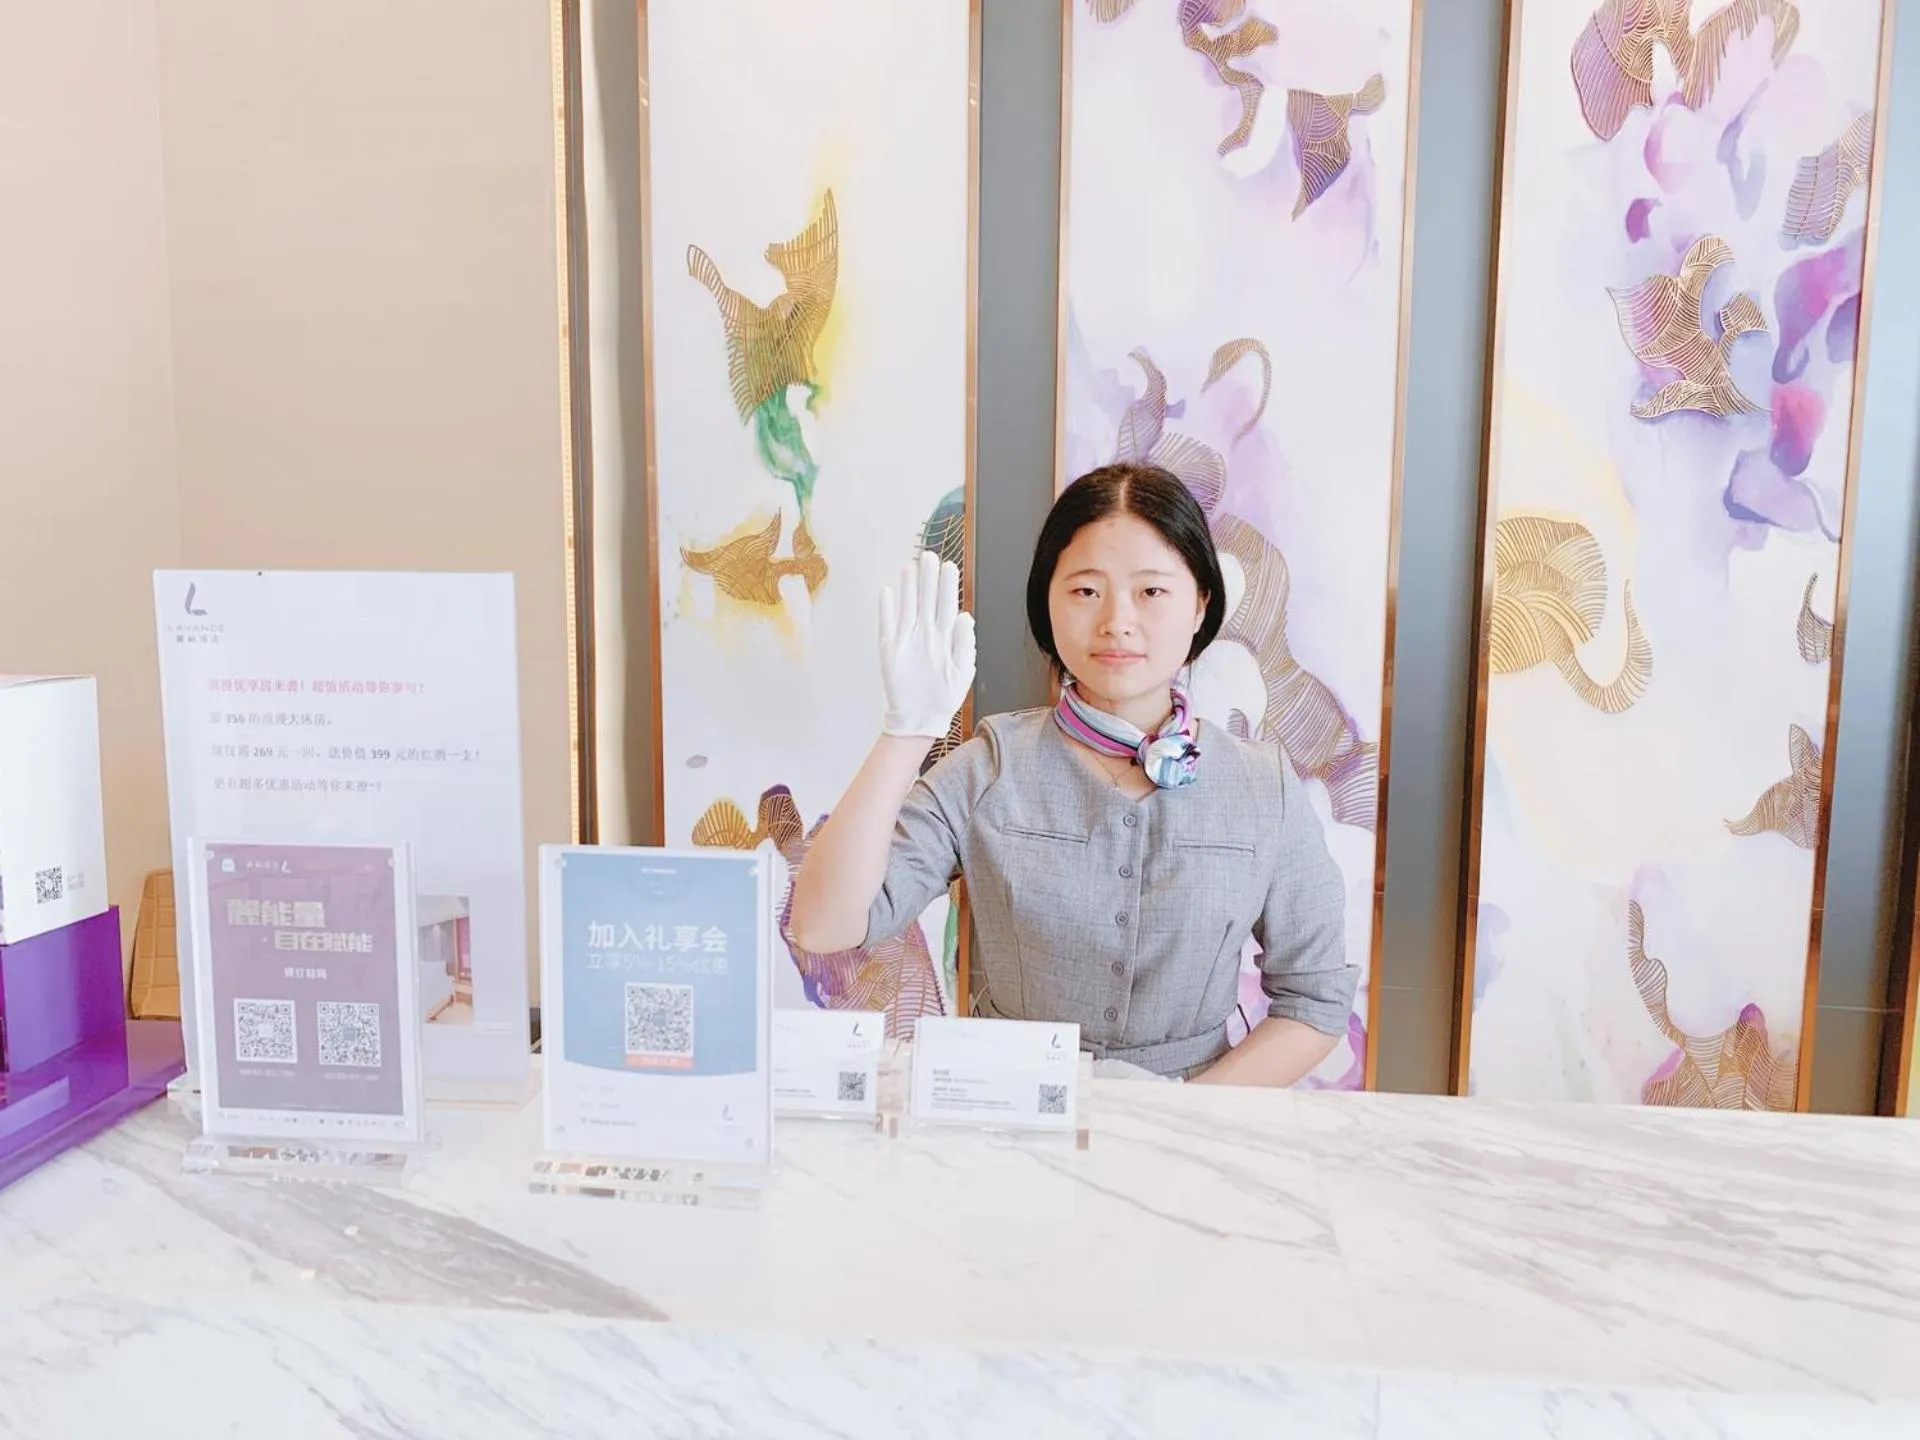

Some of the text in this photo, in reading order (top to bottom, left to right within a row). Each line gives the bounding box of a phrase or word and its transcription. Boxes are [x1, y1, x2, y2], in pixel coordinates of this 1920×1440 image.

[587, 920, 728, 953] 加入礼享会
